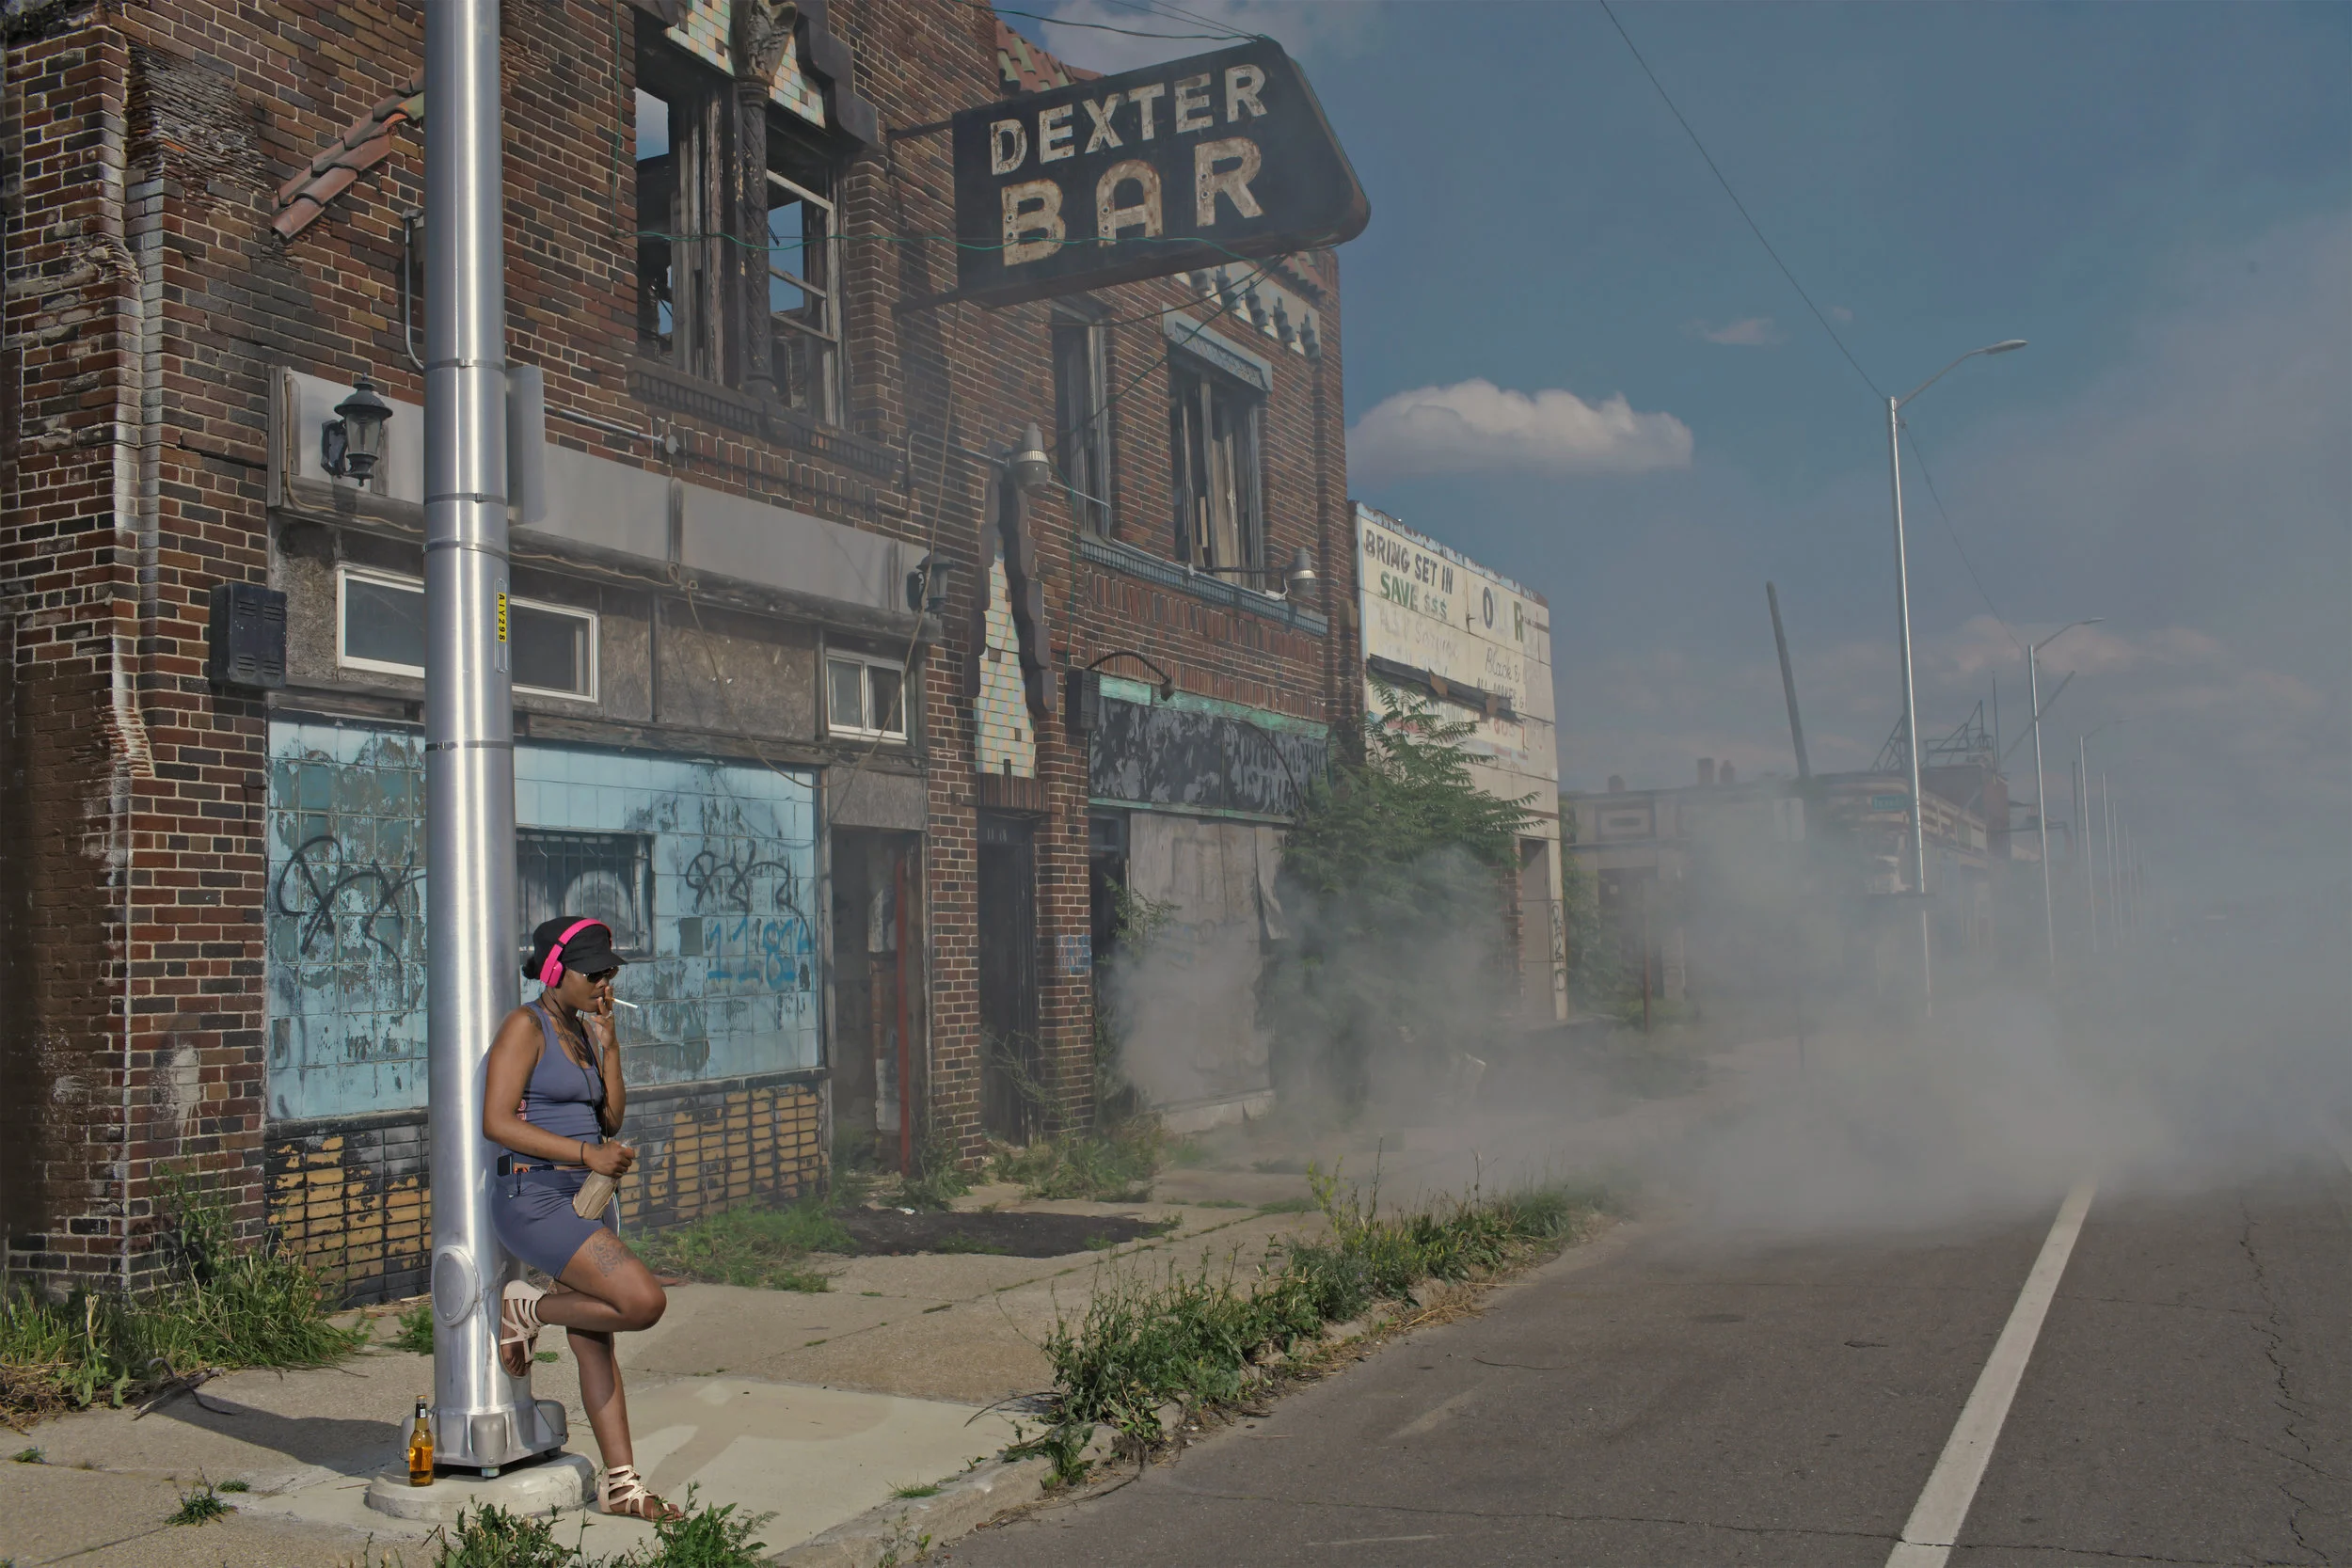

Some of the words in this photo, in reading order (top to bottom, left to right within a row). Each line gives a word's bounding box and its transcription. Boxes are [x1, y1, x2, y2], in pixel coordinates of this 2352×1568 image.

[990, 64, 1267, 176] DEXTER
[1001, 136, 1264, 266] BAR
[1364, 529, 1410, 574] BRING
[1414, 553, 1438, 587] SET
[1441, 564, 1454, 594] IN
[1380, 570, 1419, 611] SAVE
